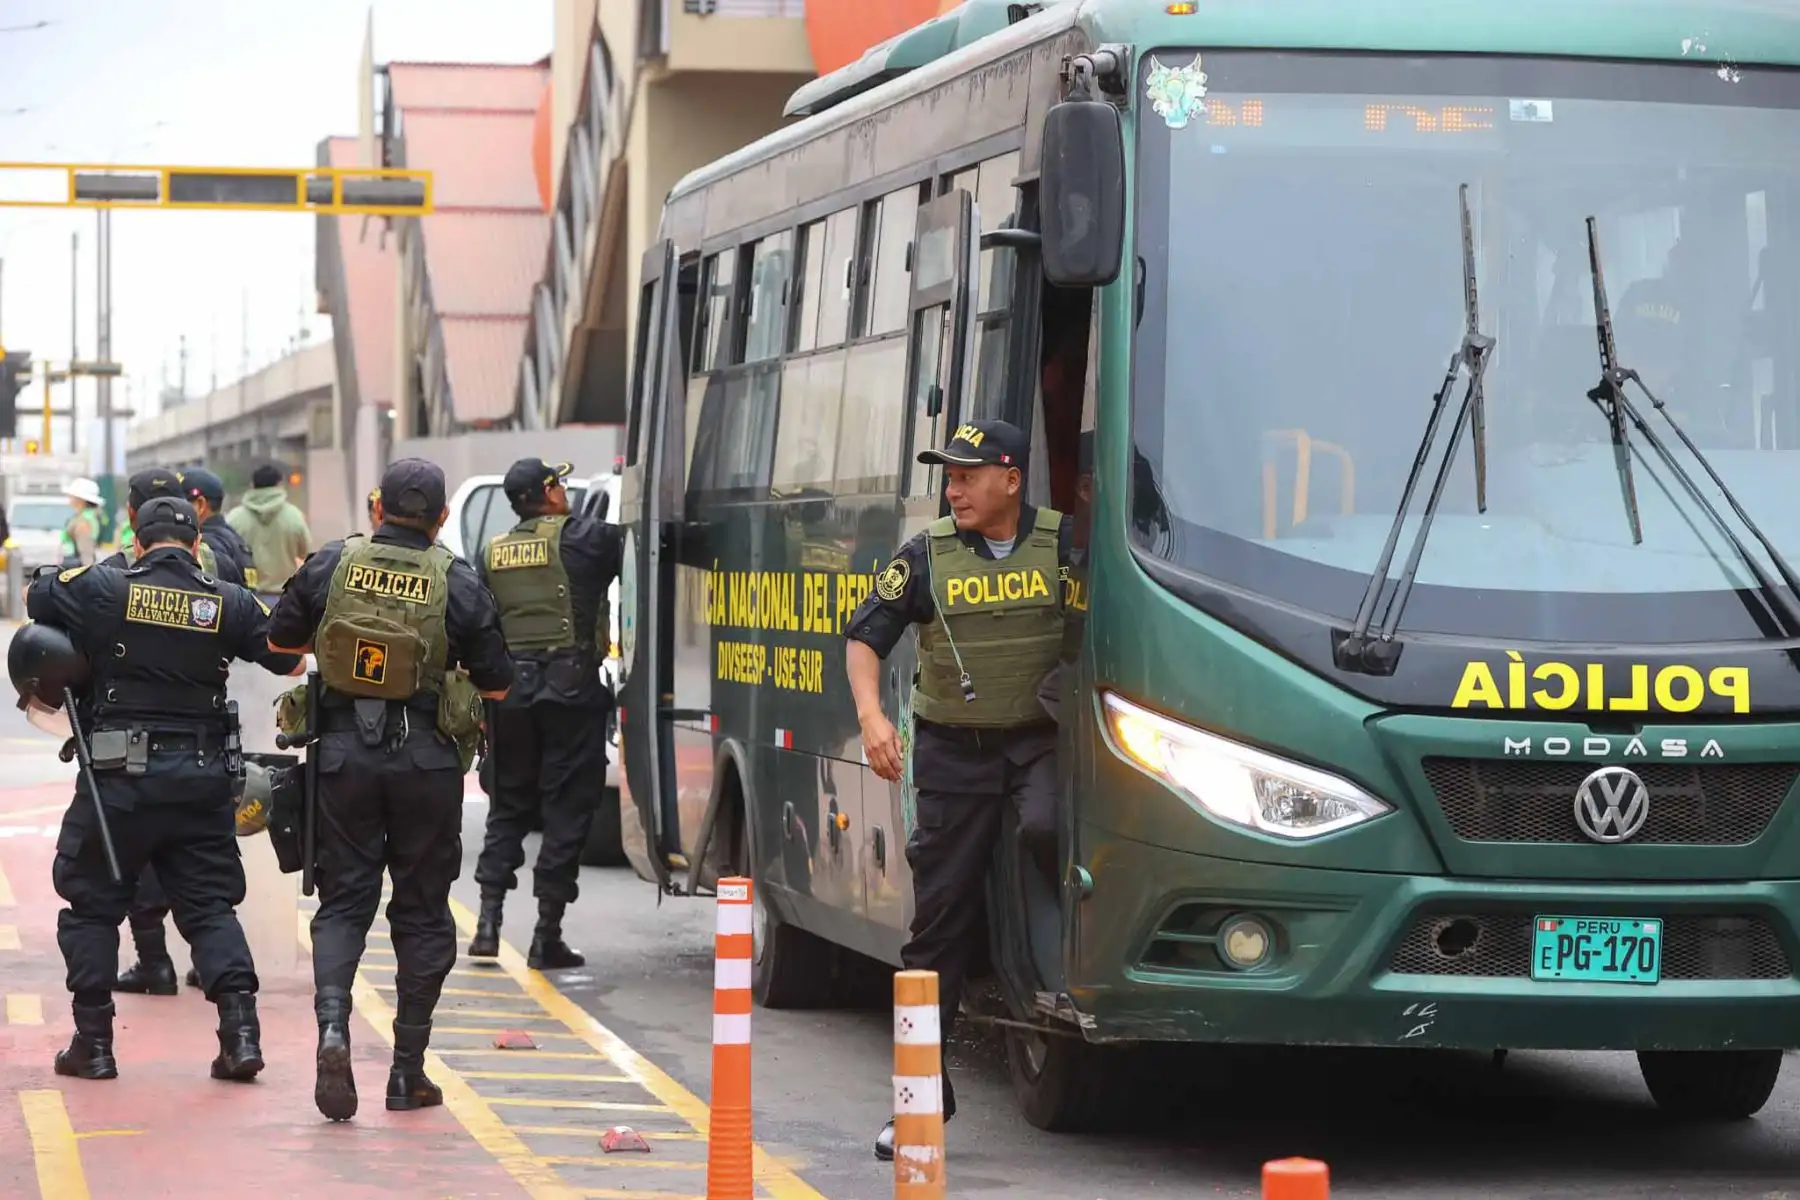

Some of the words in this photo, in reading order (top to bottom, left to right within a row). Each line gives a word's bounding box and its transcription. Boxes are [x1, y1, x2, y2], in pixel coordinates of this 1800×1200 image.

[492, 543, 546, 566] POLICIA
[348, 567, 425, 599] POLICIA
[947, 570, 1049, 606] POLICIA
[130, 606, 190, 625] SALVATAJE
[131, 587, 190, 613] POLICIA
[729, 572, 799, 632] NACIONAL
[803, 572, 832, 634] DEL
[717, 641, 766, 685] DIVSEESP
[774, 646, 796, 690] USE
[799, 649, 823, 694] SUR
[1504, 737, 1724, 758] MODASA
[1575, 767, 1648, 842] VW
[1576, 921, 1621, 934] PERU
[1557, 934, 1656, 973] PG-170
